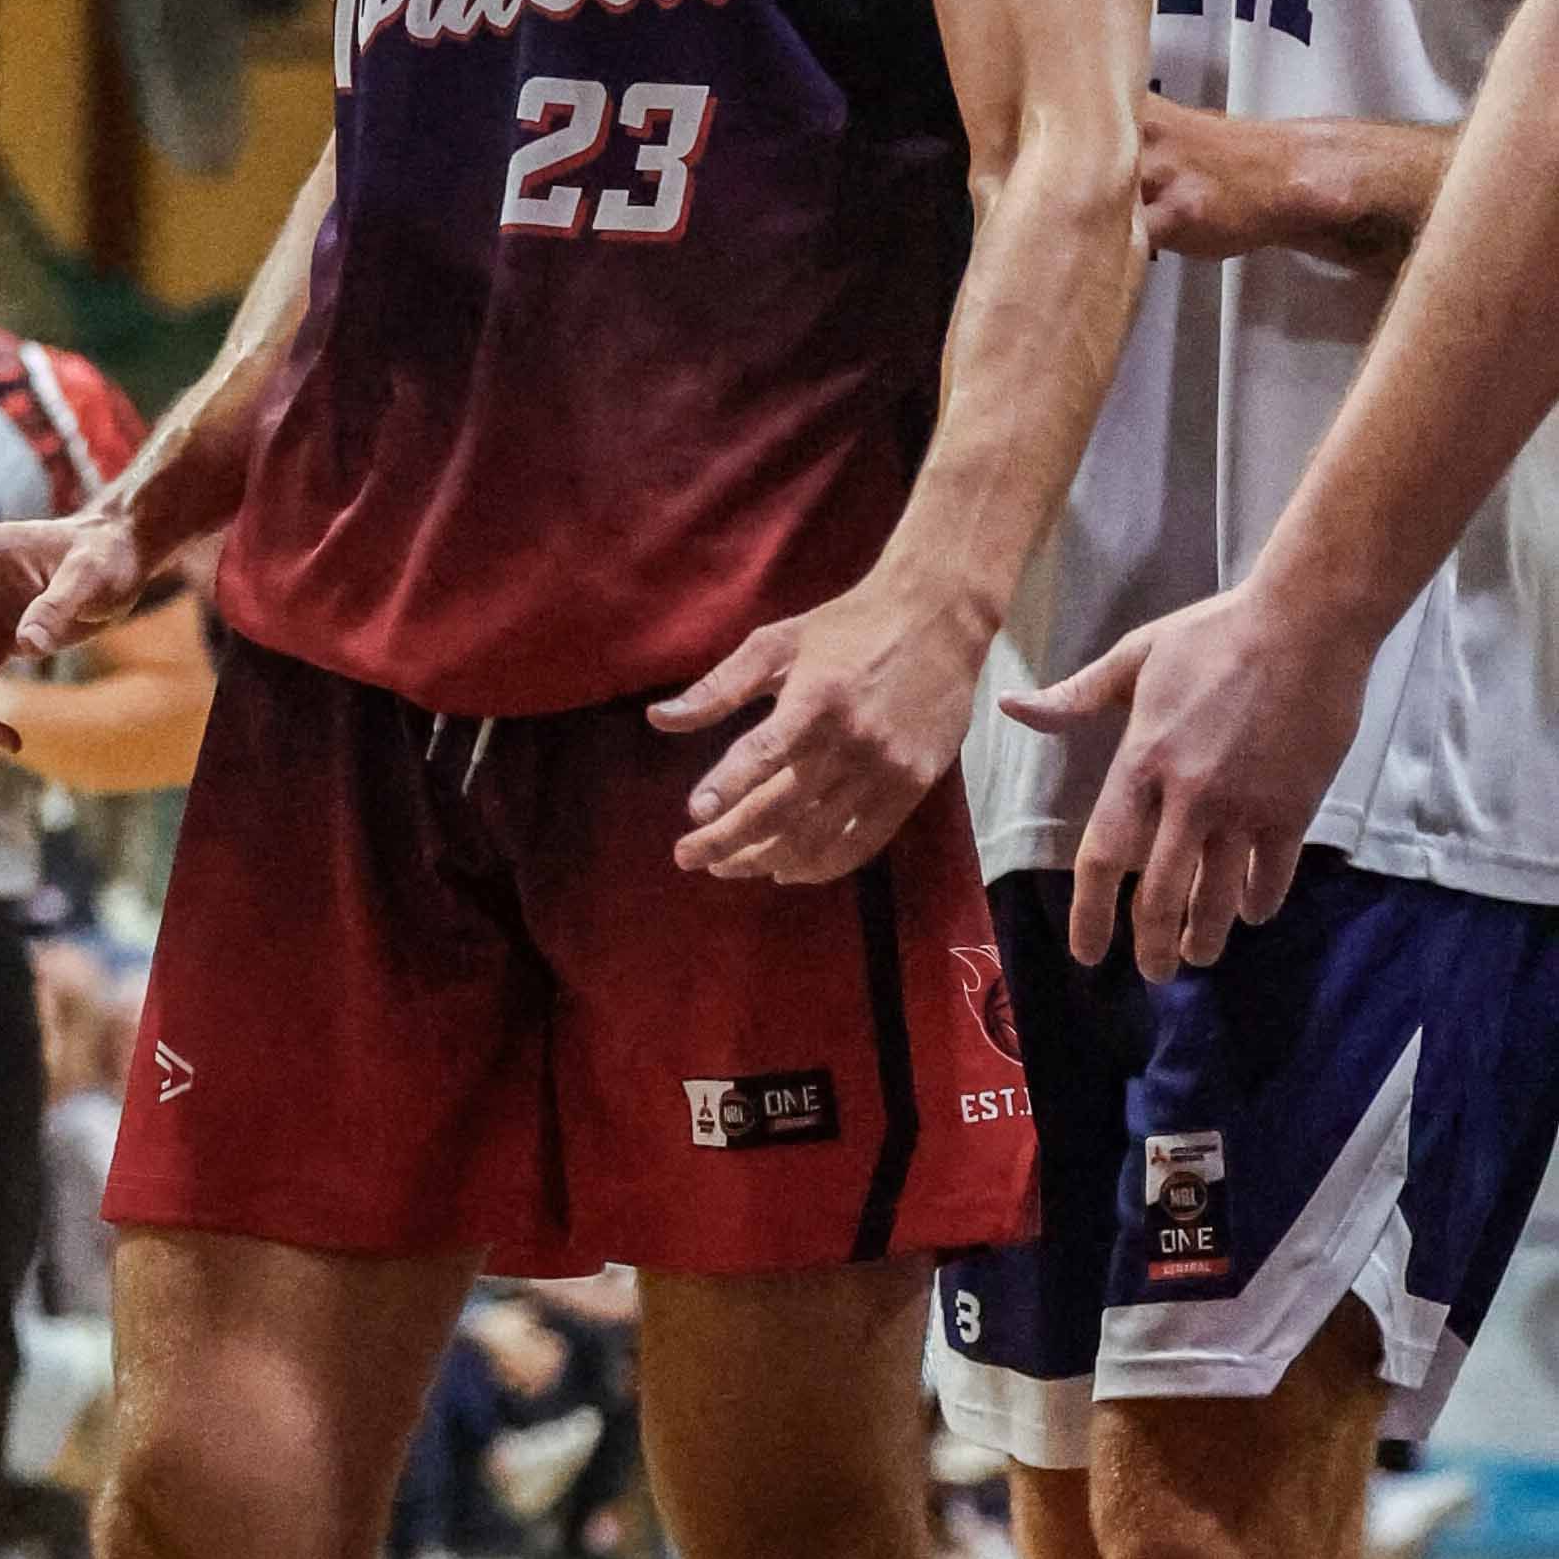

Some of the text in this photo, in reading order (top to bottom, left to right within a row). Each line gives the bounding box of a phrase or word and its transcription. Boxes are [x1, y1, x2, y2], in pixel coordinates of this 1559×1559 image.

[499, 76, 719, 241] 23
[764, 1085, 821, 1116] ONE
[1161, 1226, 1214, 1253] ONE
